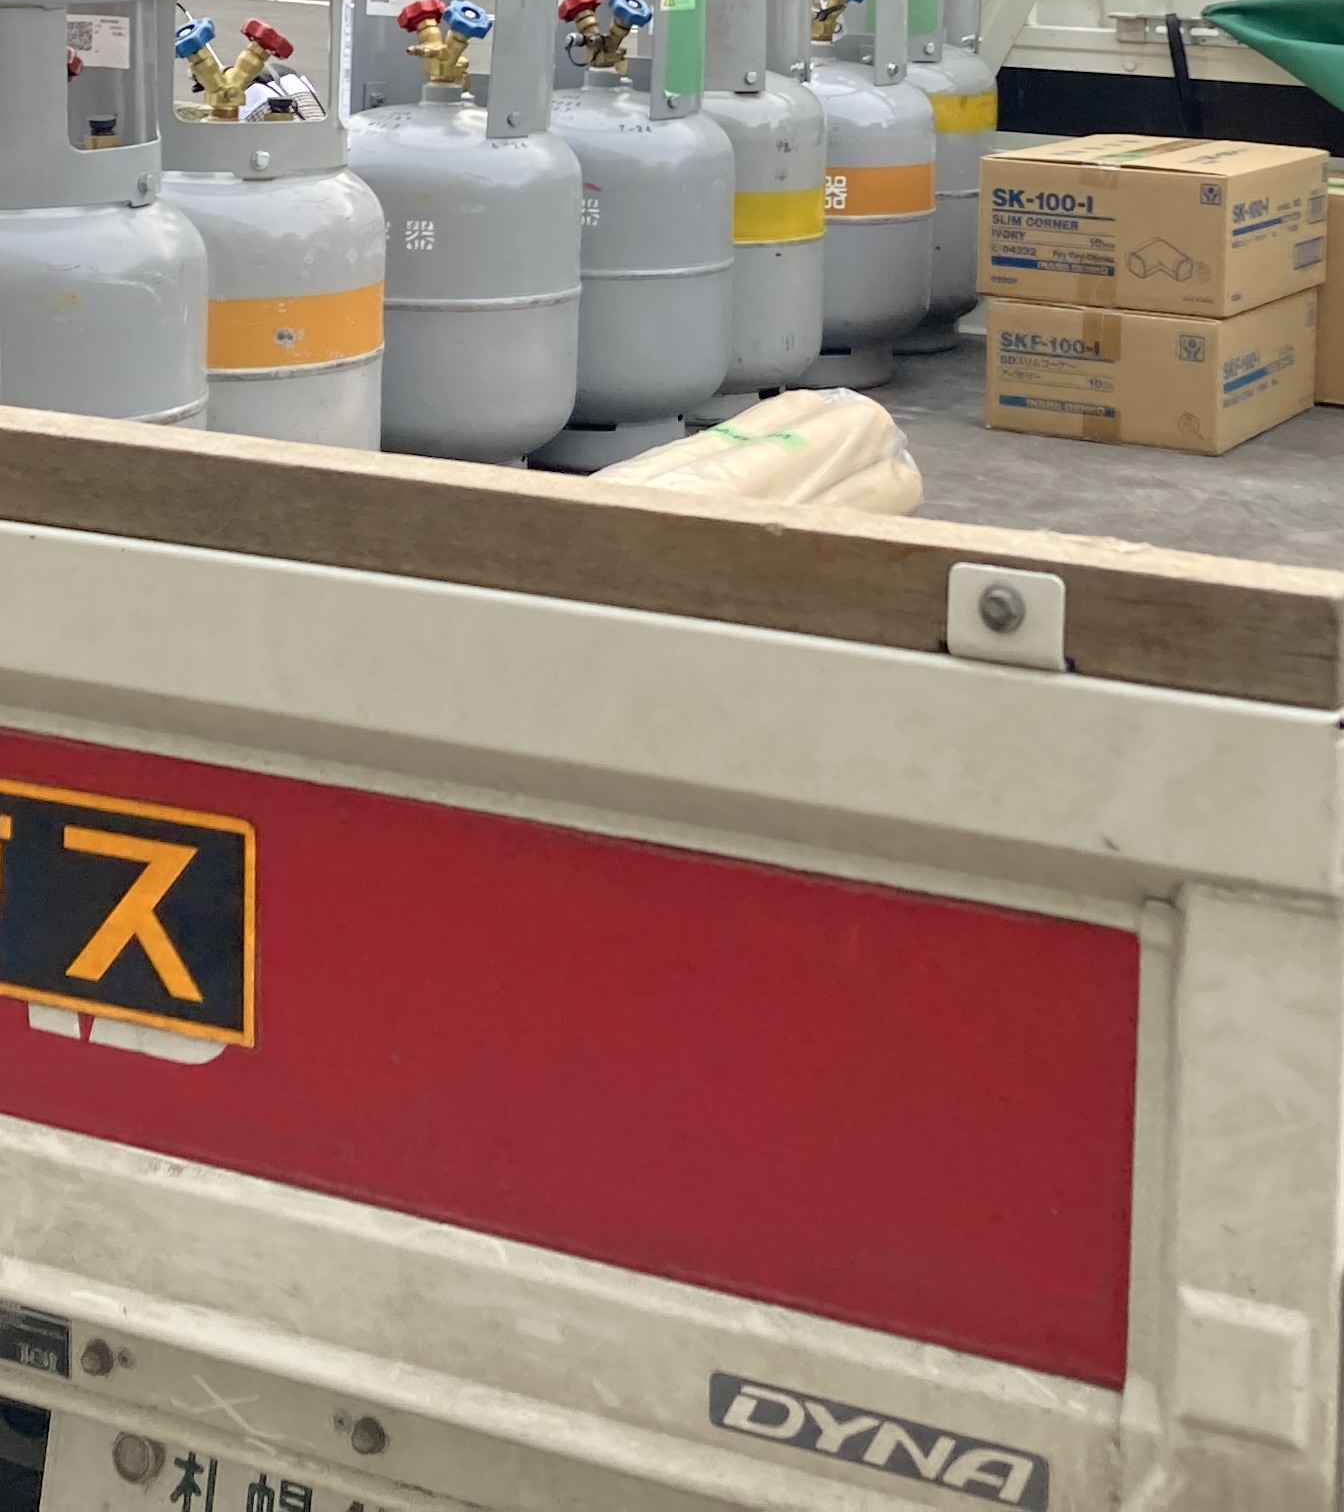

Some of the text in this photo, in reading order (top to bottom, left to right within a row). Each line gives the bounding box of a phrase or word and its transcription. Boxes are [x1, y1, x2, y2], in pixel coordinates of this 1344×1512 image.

[992, 188, 1093, 214] SK-100-I
[992, 214, 1078, 231] SLIM CORNER
[992, 229, 1025, 240] IVORY
[1001, 332, 1100, 356] SKF-100-I
[722, 1384, 1034, 1504] DYNA
